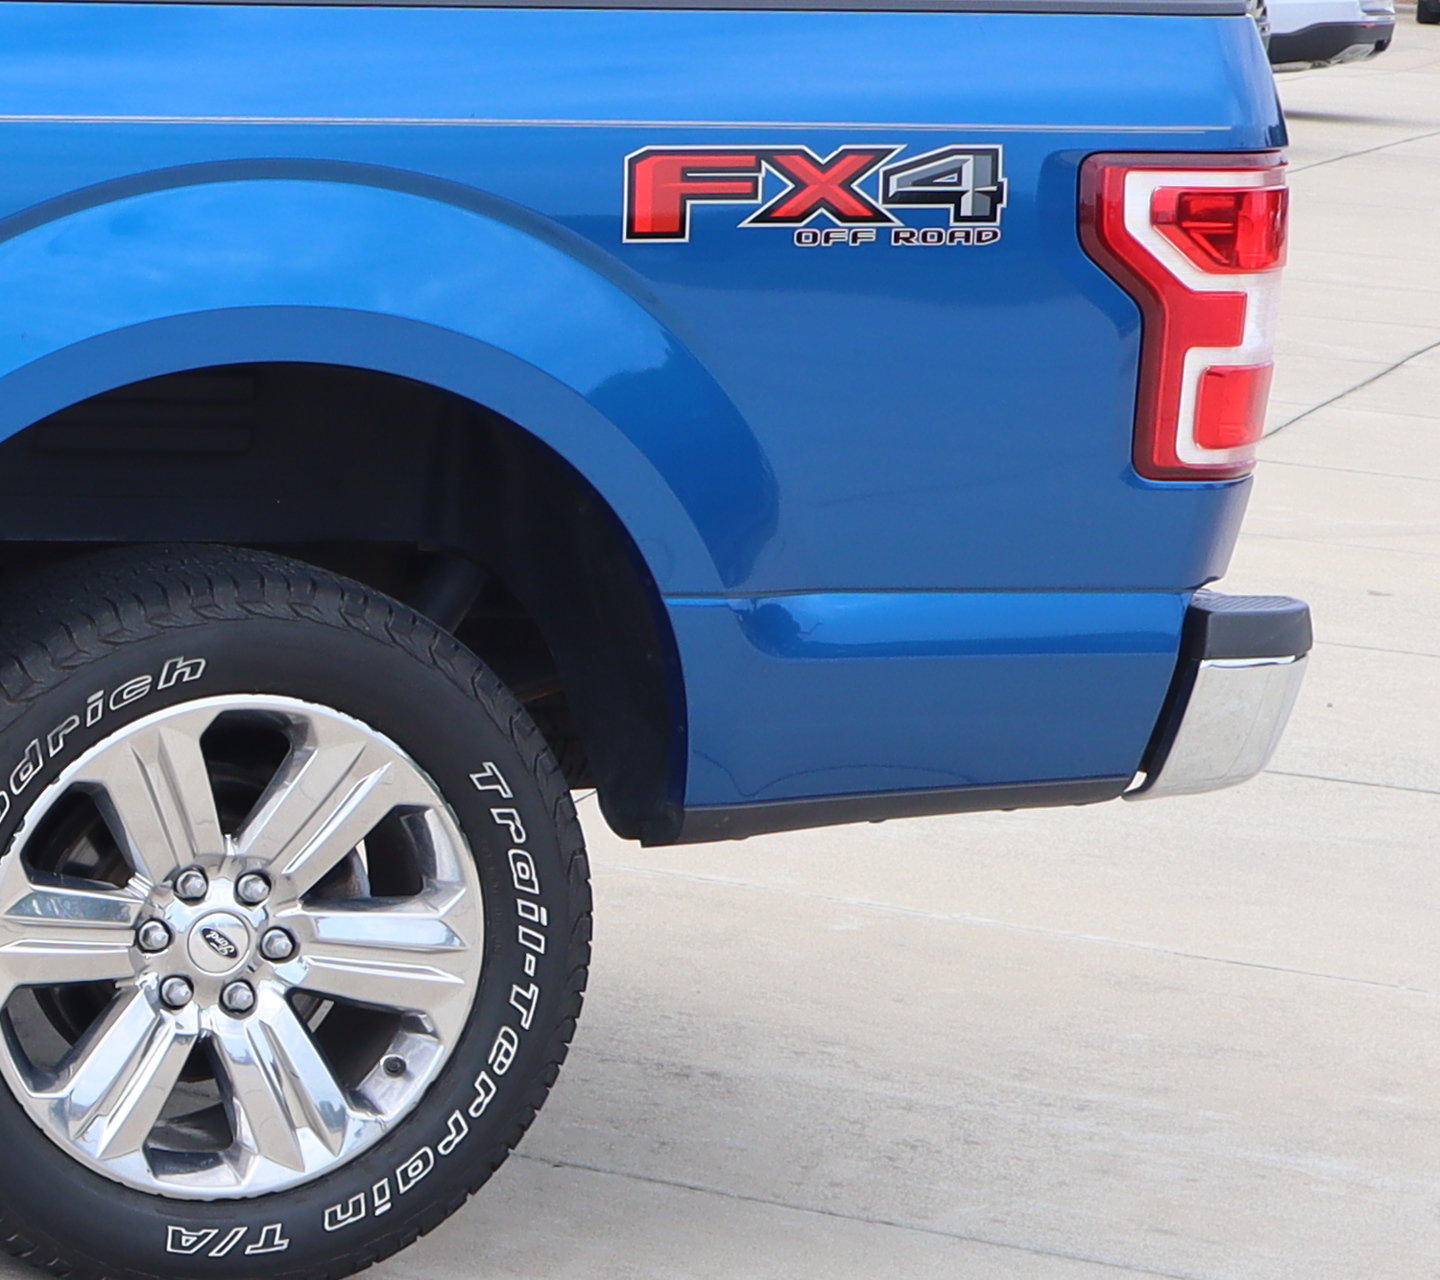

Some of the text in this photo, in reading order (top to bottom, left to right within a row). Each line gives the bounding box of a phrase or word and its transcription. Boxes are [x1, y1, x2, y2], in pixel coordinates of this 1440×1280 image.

[623, 144, 1008, 243] FX4
[794, 227, 1001, 248] OFF ROAD
[165, 761, 549, 1258] Trail-Terrain T/A
